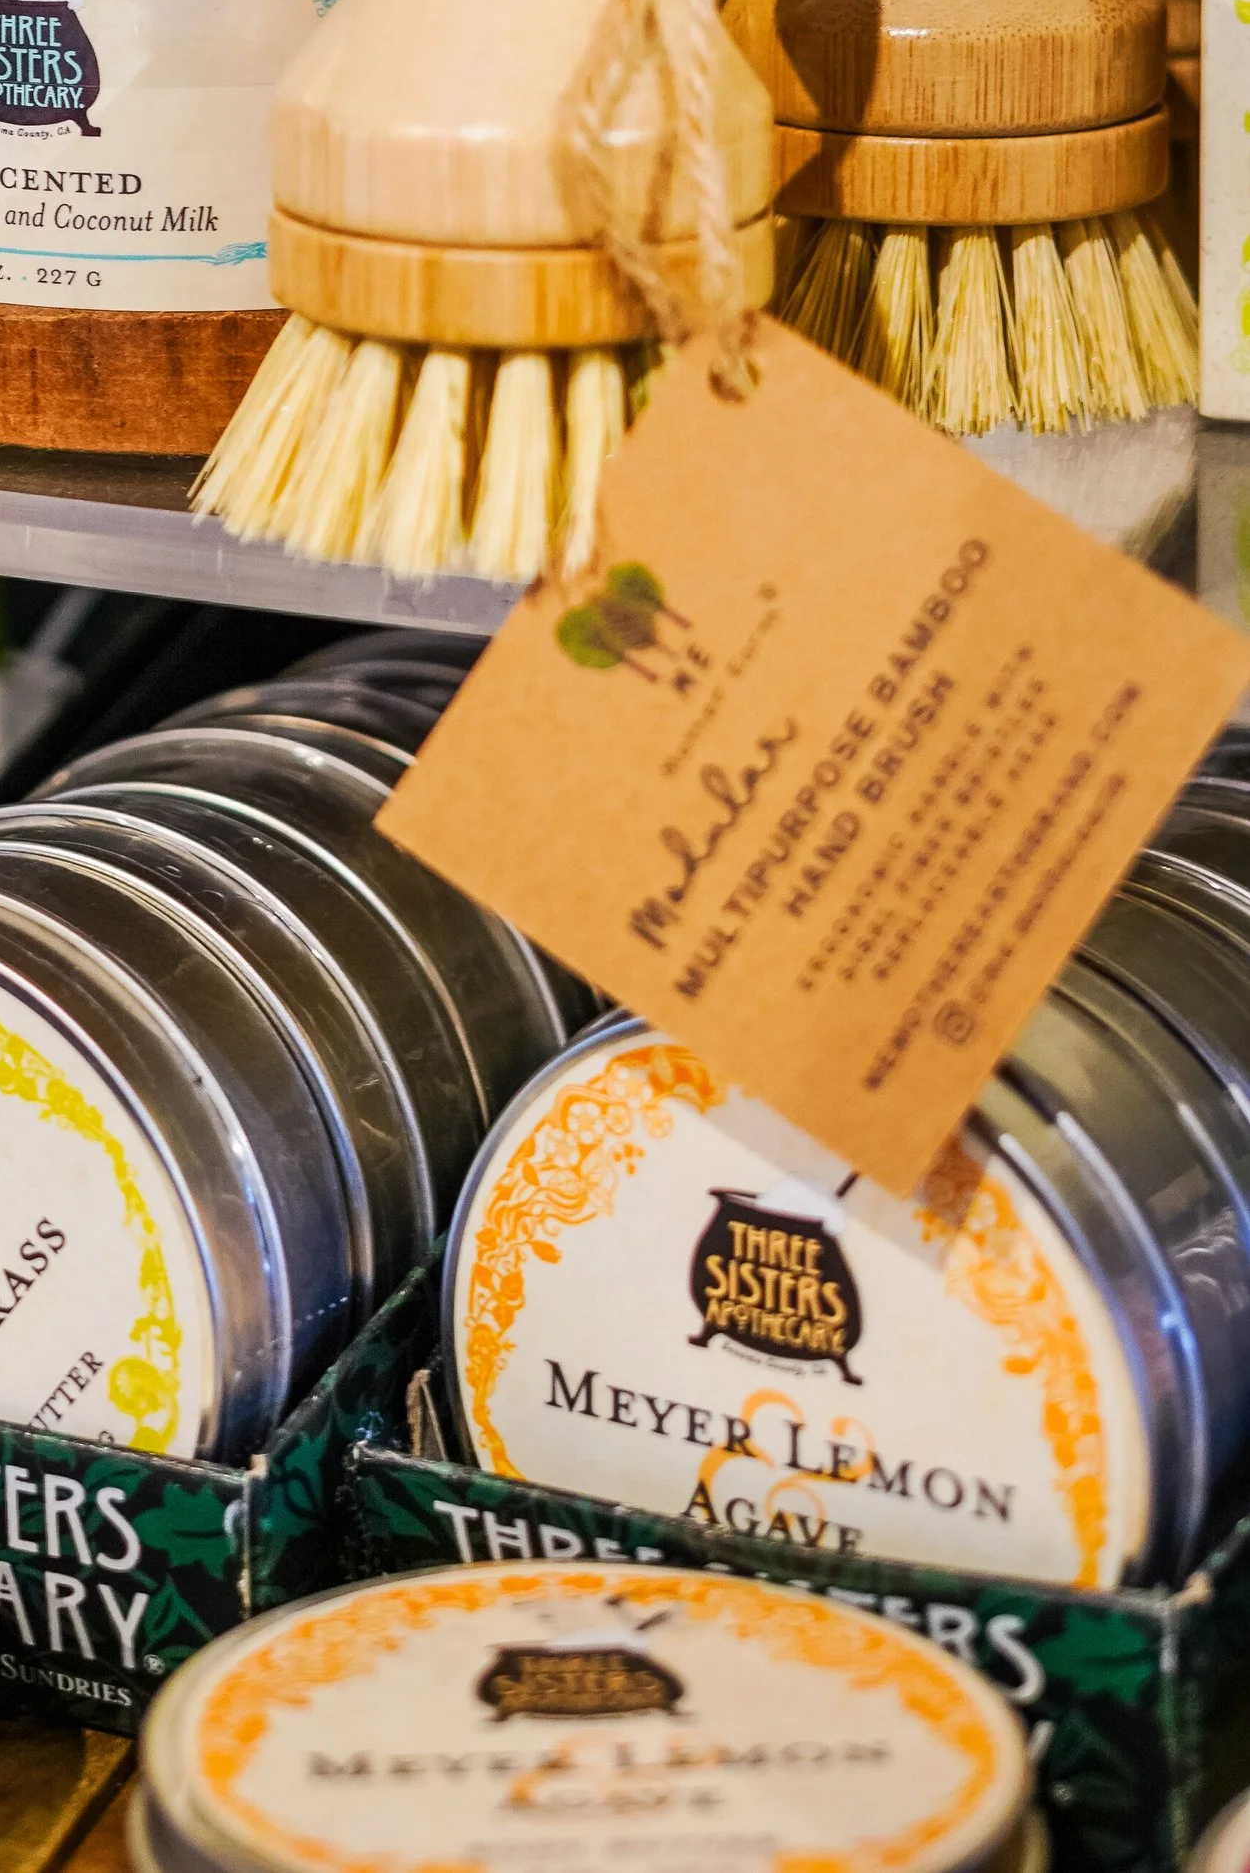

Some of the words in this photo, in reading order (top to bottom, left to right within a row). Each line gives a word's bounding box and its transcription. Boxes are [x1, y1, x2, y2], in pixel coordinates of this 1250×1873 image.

[4, 203, 46, 228] and
[53, 205, 154, 232] Coconut
[161, 205, 219, 233] Milk
[36, 268, 77, 286] 227
[86, 271, 102, 288] G
[674, 709, 874, 1001] MULTIPURPOSE
[869, 536, 991, 704] BAMBOO
[783, 811, 863, 920] HAND
[857, 672, 955, 806] BRUSH
[727, 1220, 822, 1276] THREE
[704, 1254, 848, 1326] SISTERS
[544, 1358, 757, 1459] MEYER
[783, 1421, 1017, 1524] LEMON
[0, 1653, 134, 1709] SUNDRIES
